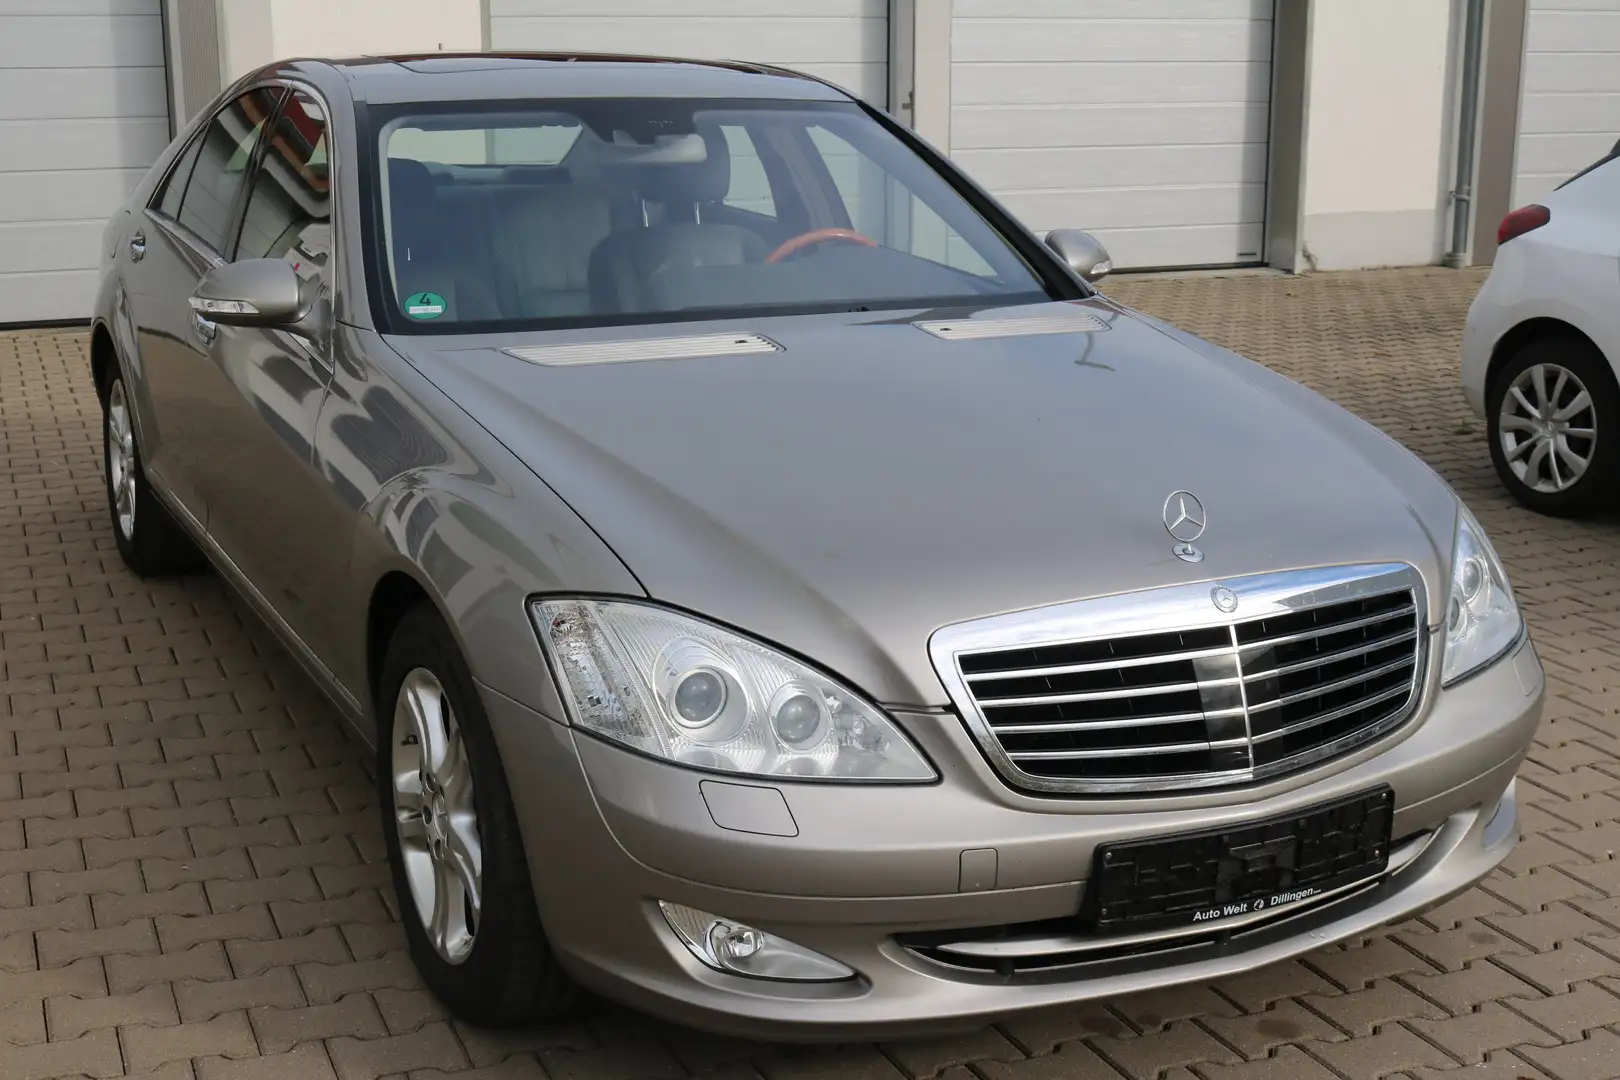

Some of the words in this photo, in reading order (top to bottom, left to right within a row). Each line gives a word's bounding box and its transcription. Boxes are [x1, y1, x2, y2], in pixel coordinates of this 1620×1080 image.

[419, 293, 431, 306] 4
[1193, 909, 1220, 921] Auto
[1223, 903, 1248, 916] Welt
[1270, 888, 1313, 906] Dillingen
